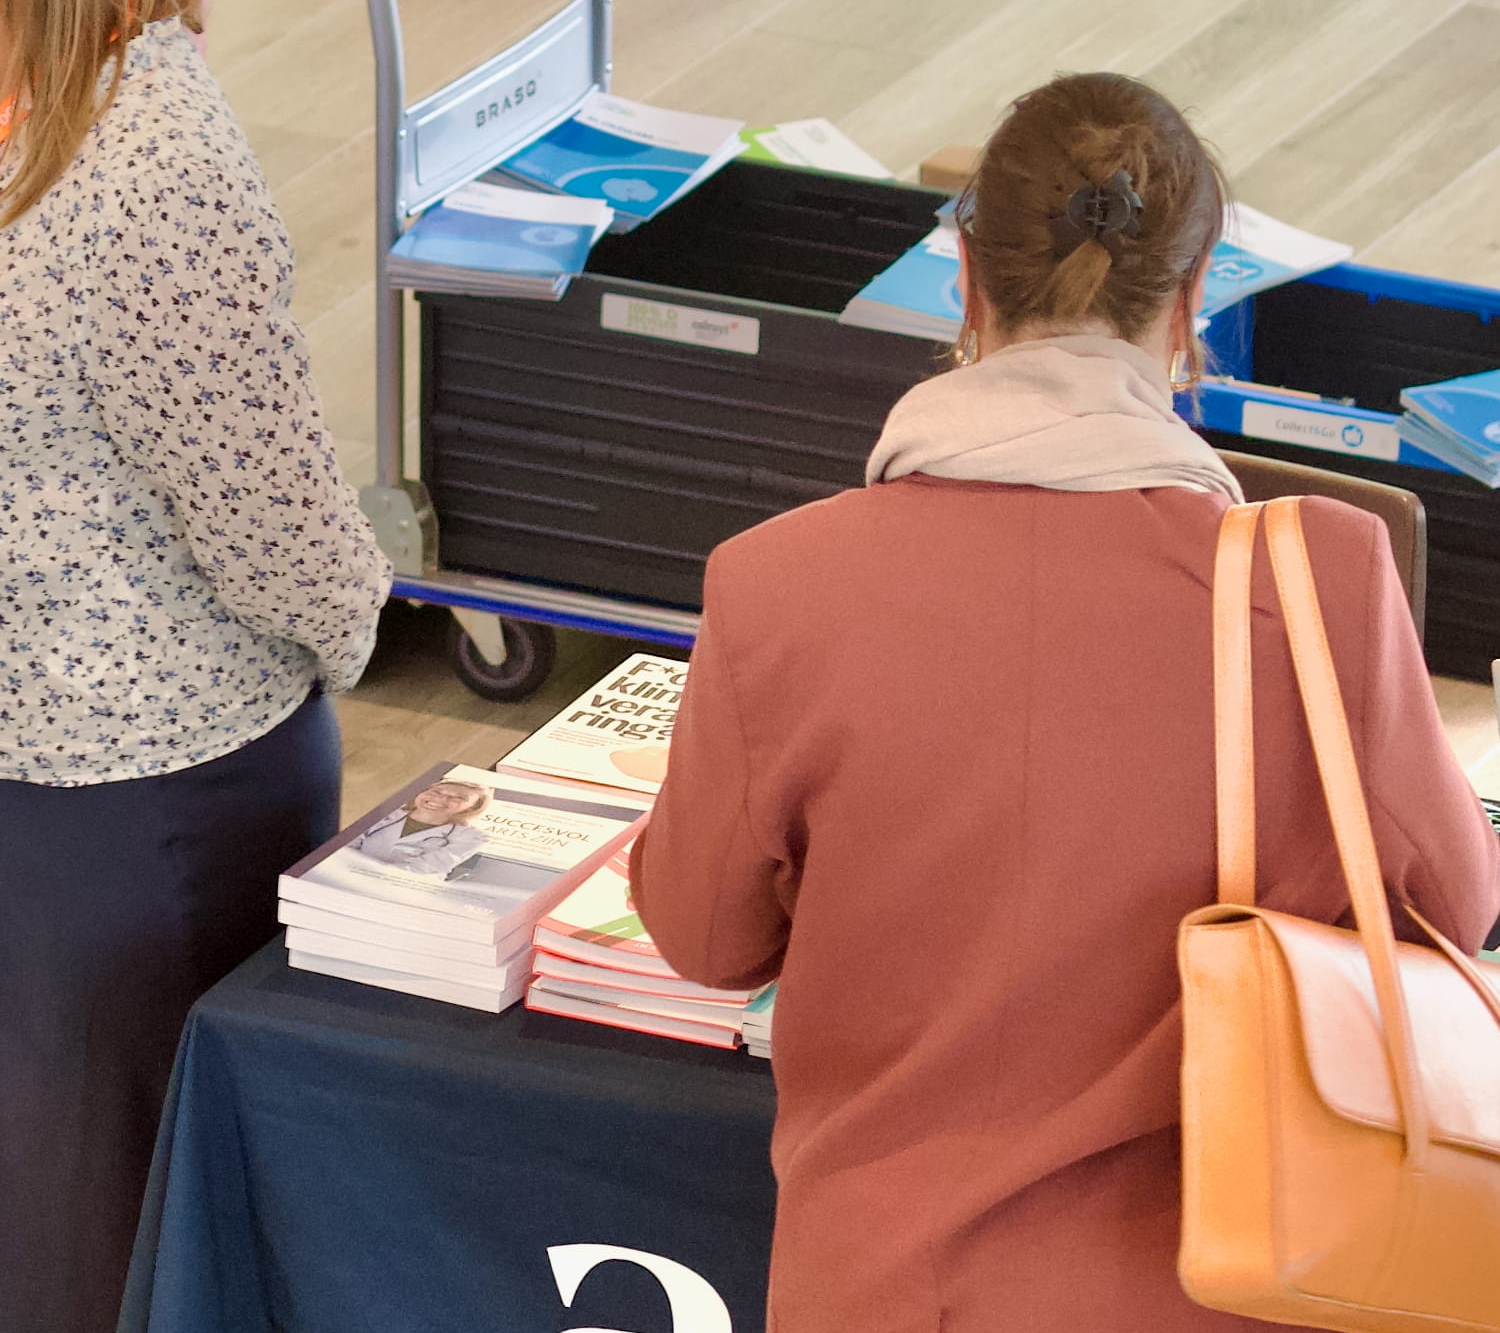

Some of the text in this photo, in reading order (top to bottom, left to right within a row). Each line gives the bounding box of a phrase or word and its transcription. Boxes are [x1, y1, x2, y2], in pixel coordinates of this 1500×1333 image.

[480, 813, 592, 844] SUCCESVOL
[484, 825, 528, 840] ARTS
[529, 834, 570, 849] ZIJN
